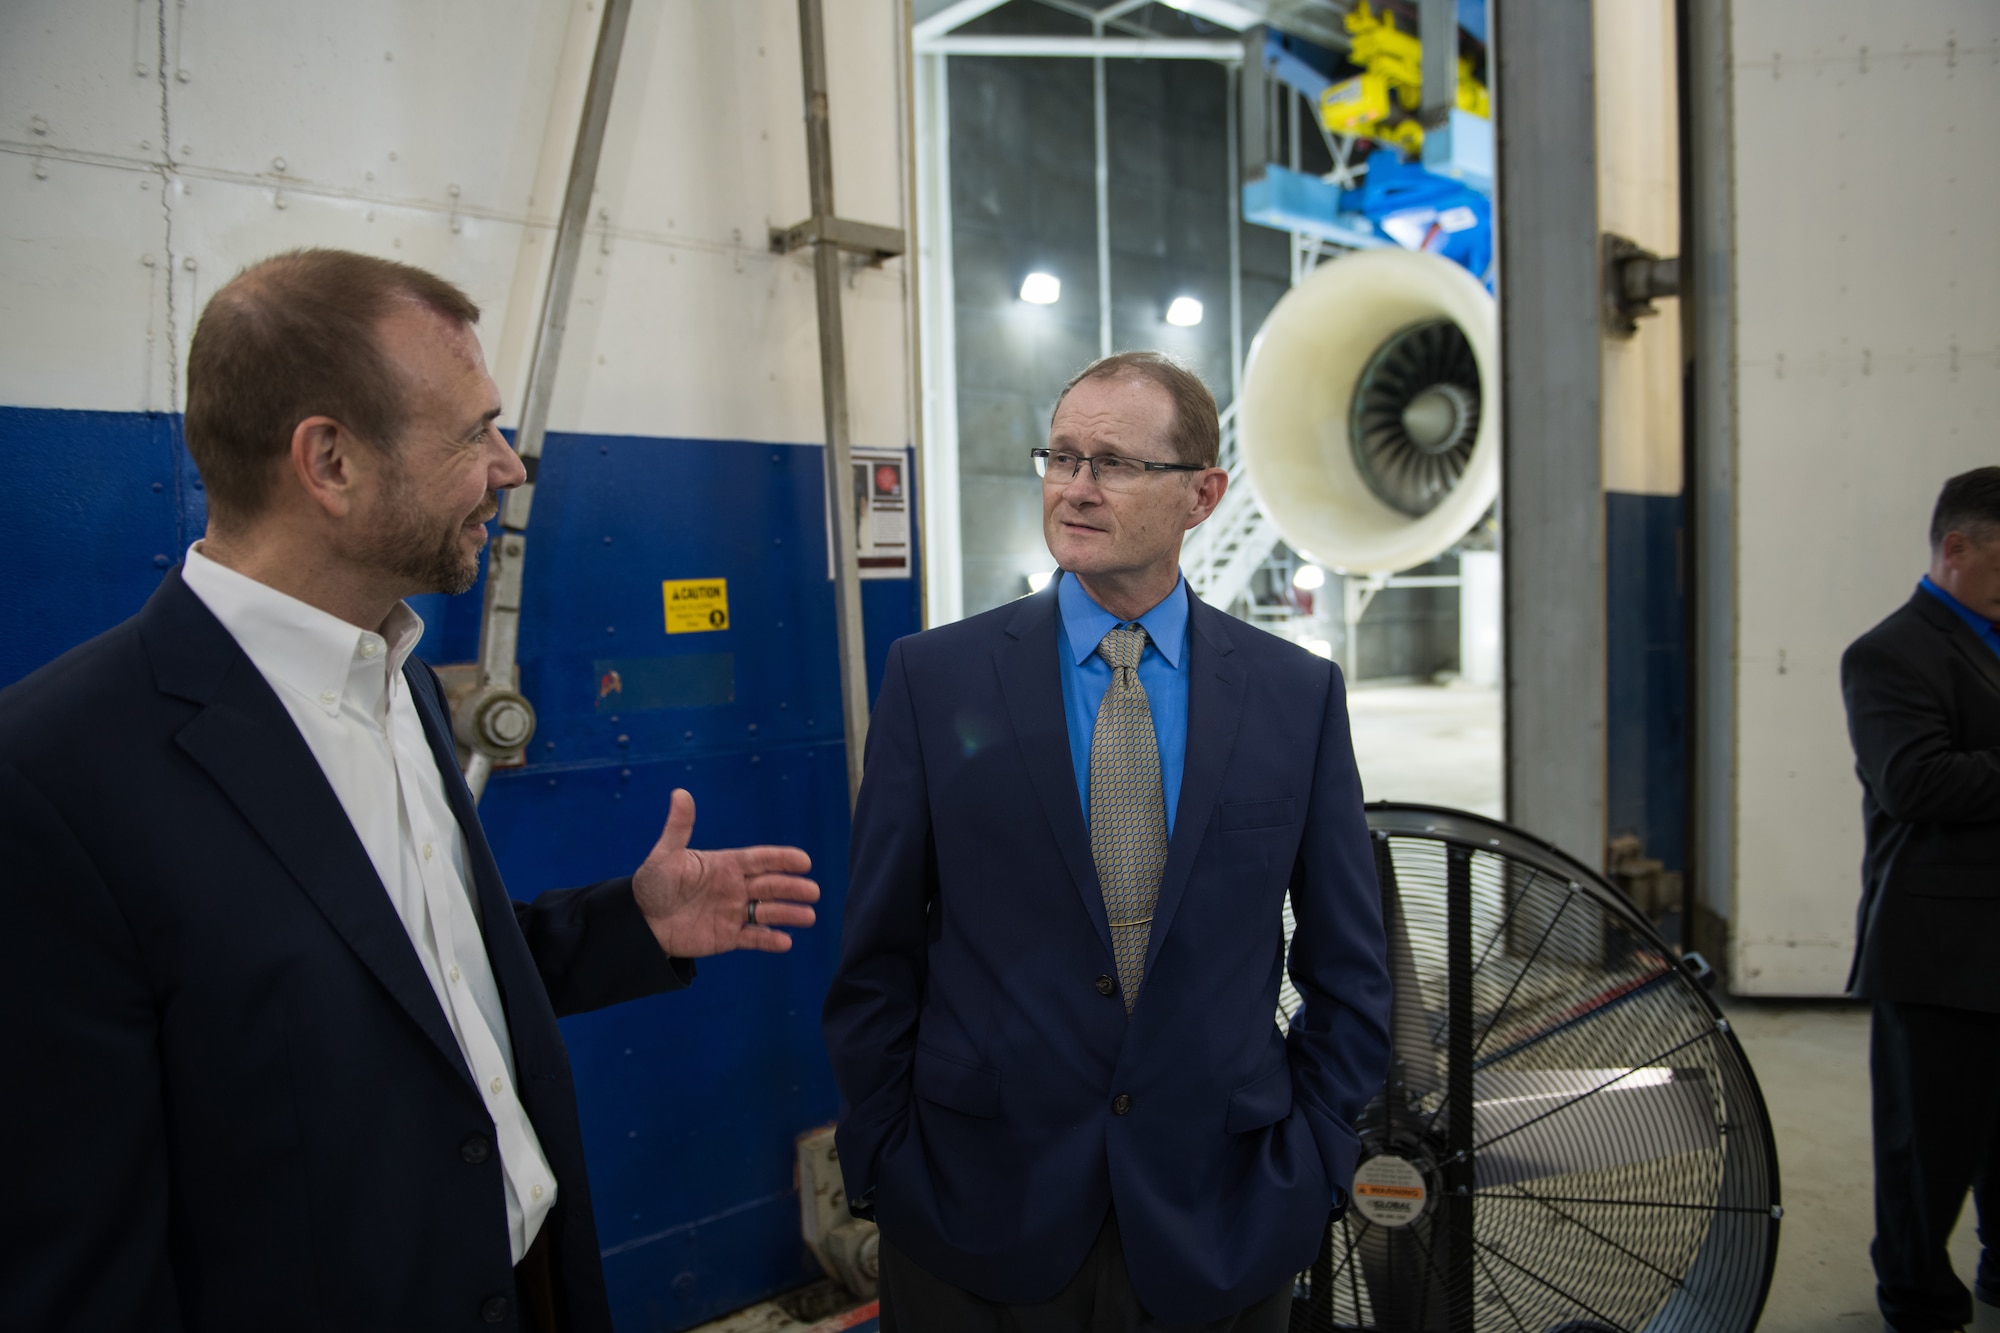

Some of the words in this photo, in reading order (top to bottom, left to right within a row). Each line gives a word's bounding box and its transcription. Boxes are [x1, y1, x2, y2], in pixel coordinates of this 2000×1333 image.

[681, 586, 720, 600] CAUTION
[1370, 1187, 1419, 1197] WARNING
[1374, 1201, 1411, 1209] GLOBAL
